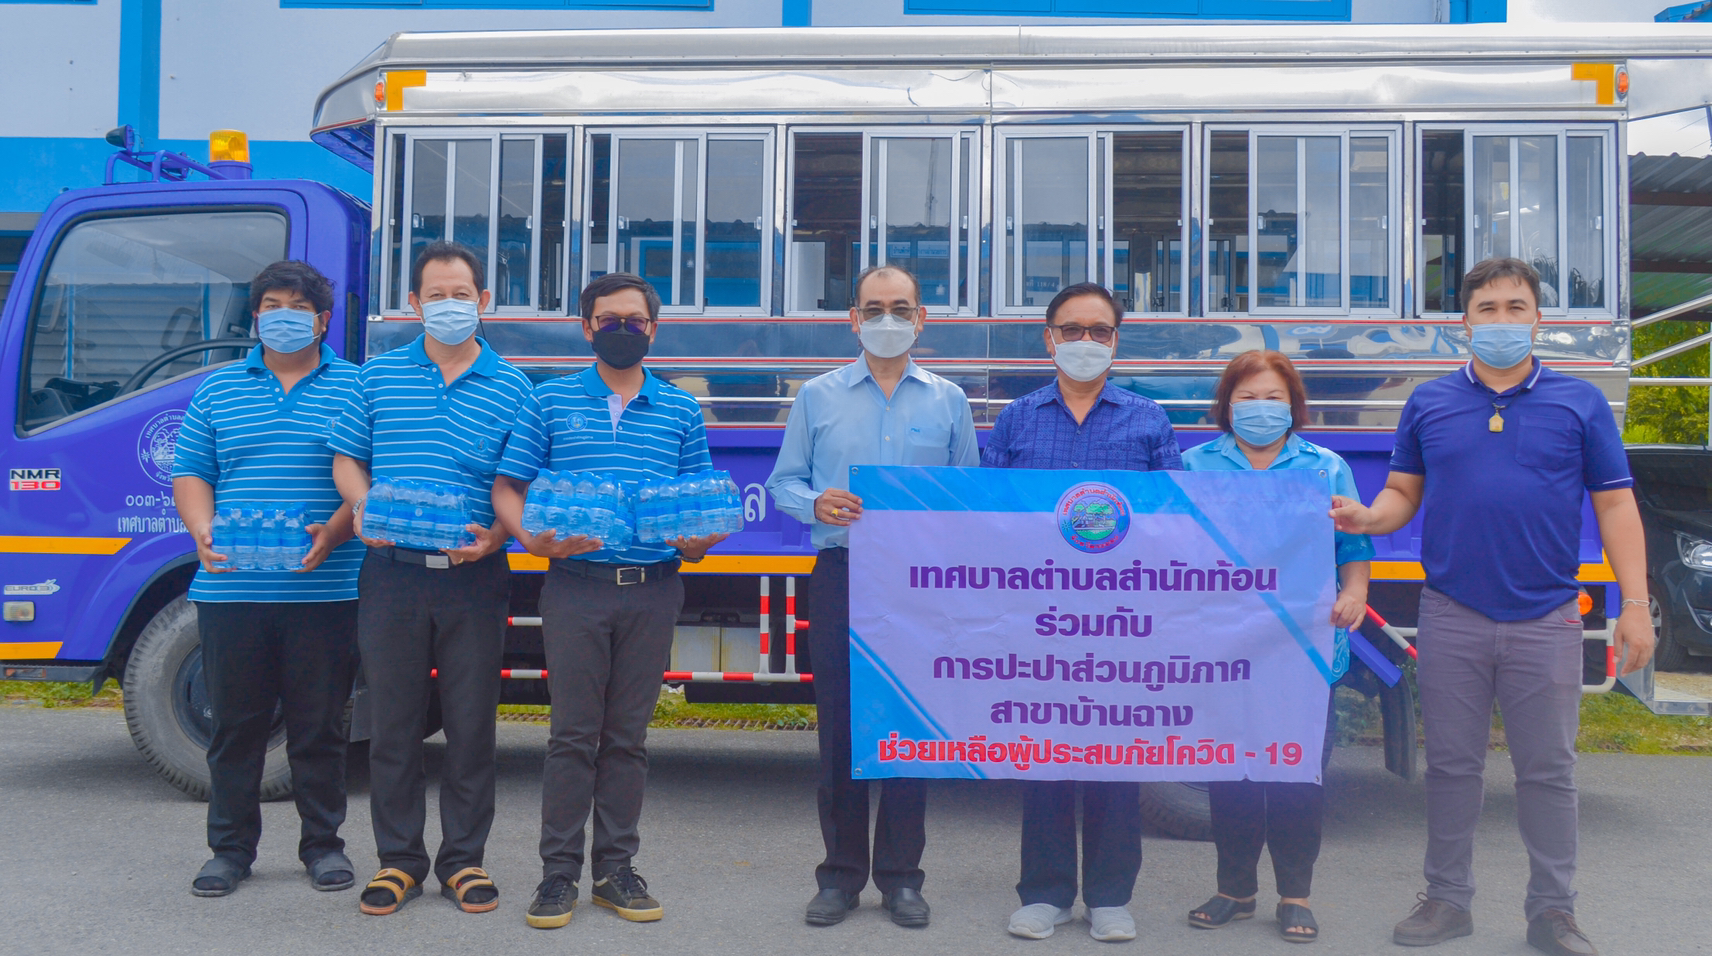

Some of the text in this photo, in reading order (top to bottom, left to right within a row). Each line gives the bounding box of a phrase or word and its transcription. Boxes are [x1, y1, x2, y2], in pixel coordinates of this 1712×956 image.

[11, 469, 60, 480] NMR
[11, 480, 60, 491] 130
[909, 559, 1277, 592] เทศบาลตำบลสำนักท้อน
[1035, 606, 1152, 637] ร่วมกับ
[933, 653, 1251, 691] การปะปาส่วนภูมิภาค
[990, 696, 1193, 727] สาขาบ้านฉาง
[878, 732, 1235, 771] ช่วยเหลือผู้ประสบภัยโควิด
[1265, 743, 1303, 766] 19
